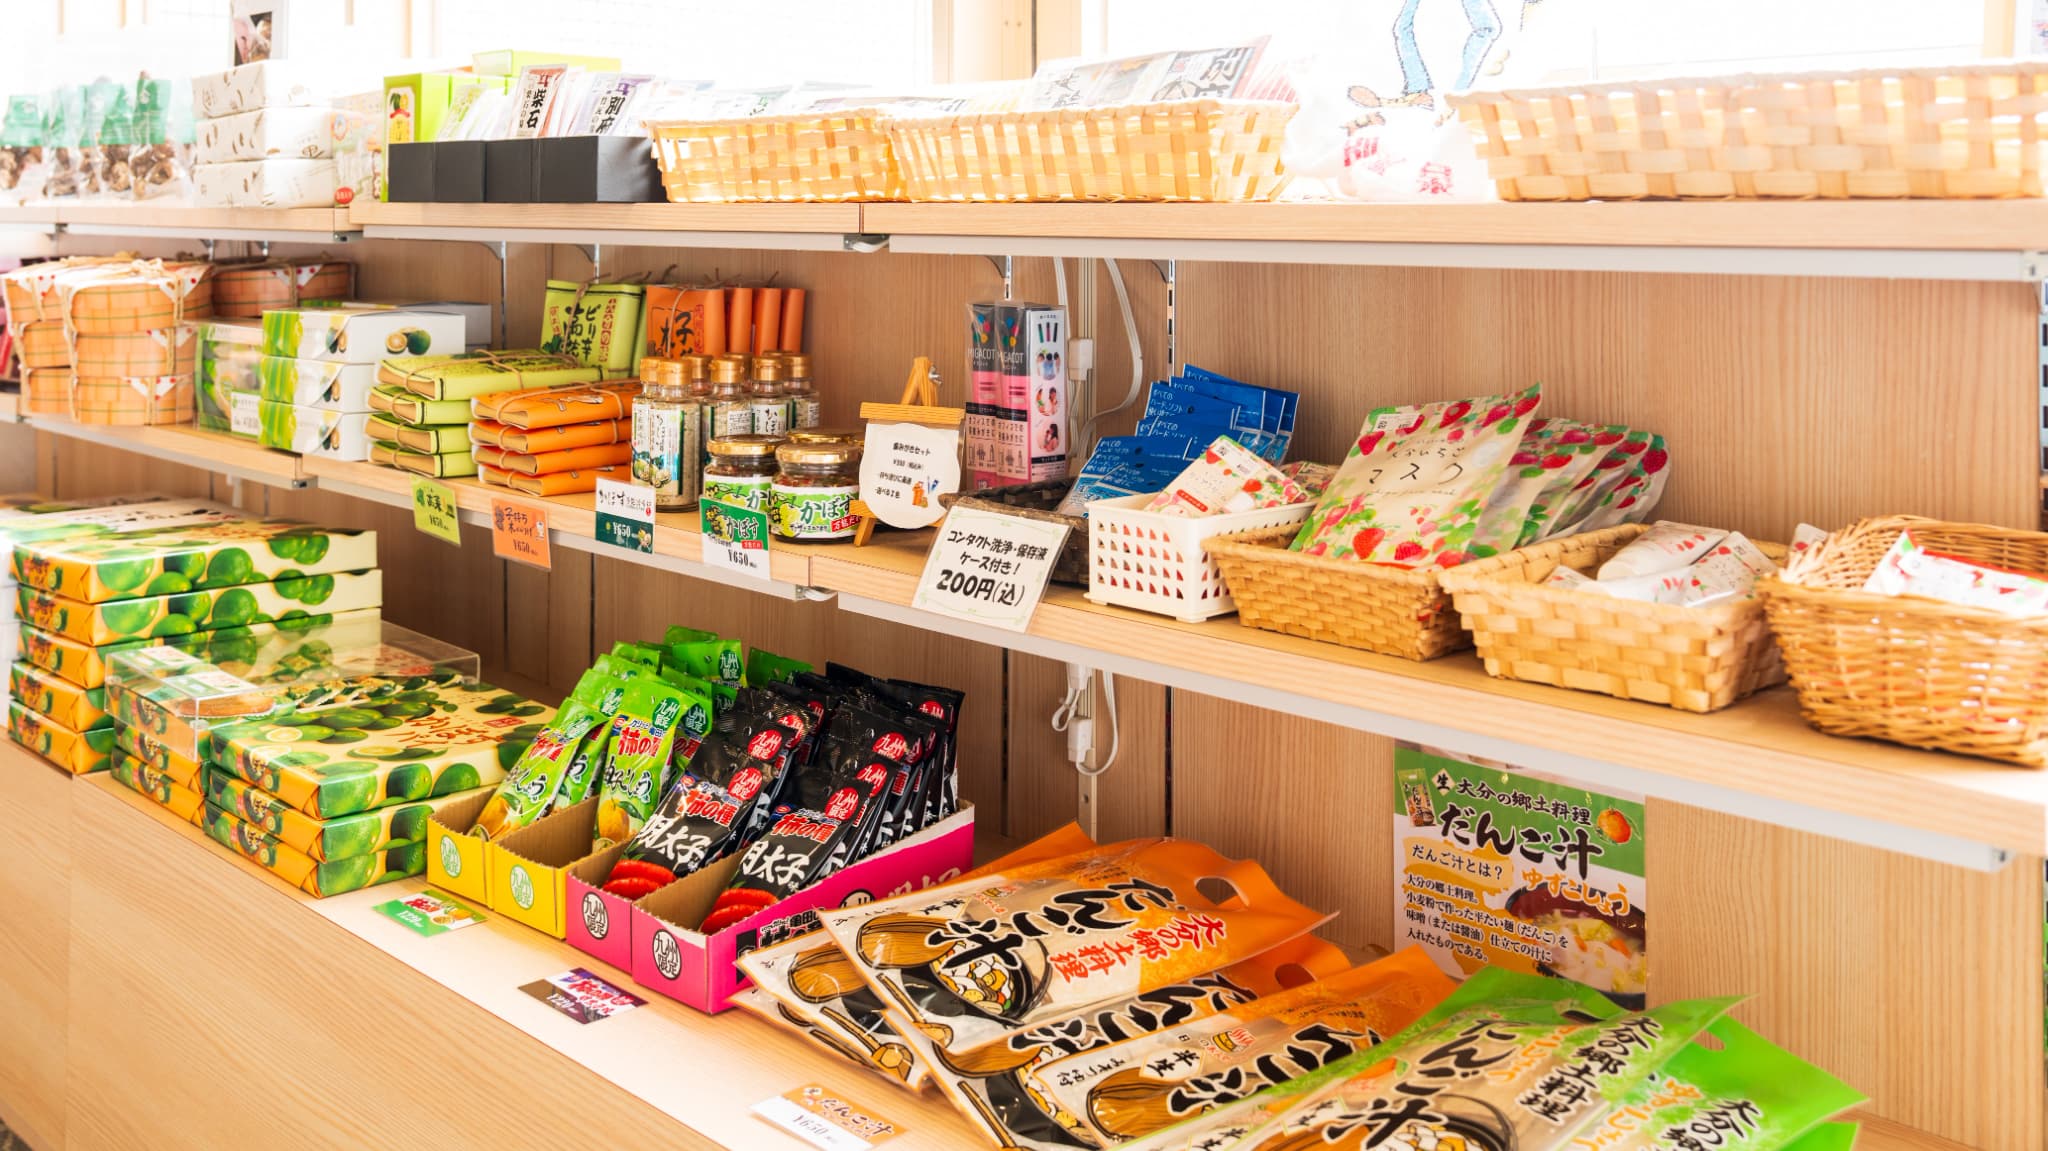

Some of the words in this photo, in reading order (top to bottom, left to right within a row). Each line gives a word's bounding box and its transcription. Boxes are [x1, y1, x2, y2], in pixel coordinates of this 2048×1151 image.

[724, 512, 761, 543] かぼす
[947, 530, 1049, 561] コンタクト洗浄・保存液
[936, 568, 1026, 608] 200円(込)
[655, 701, 680, 717] 九州
[753, 732, 782, 749] 九州
[733, 769, 762, 789] 九州
[860, 765, 887, 784] 九州
[1436, 773, 1452, 791] 生
[677, 787, 740, 829] 柿の種
[832, 790, 860, 810] 九州
[1456, 777, 1593, 827] 大分の郷土料理
[773, 812, 838, 845] 柿の種
[1440, 803, 1604, 880] だんご汁
[585, 894, 607, 921] 九州
[1521, 867, 1631, 917] ゆずこしょう
[587, 915, 608, 939] 限定
[925, 876, 1188, 971] だんご汁
[655, 934, 681, 962] 九州
[1047, 913, 1227, 984] 大分の郷土料理
[1406, 927, 1489, 963] 入れたものである。
[657, 953, 679, 976] 限定
[1518, 1015, 1663, 1124] 大分の郷土料理
